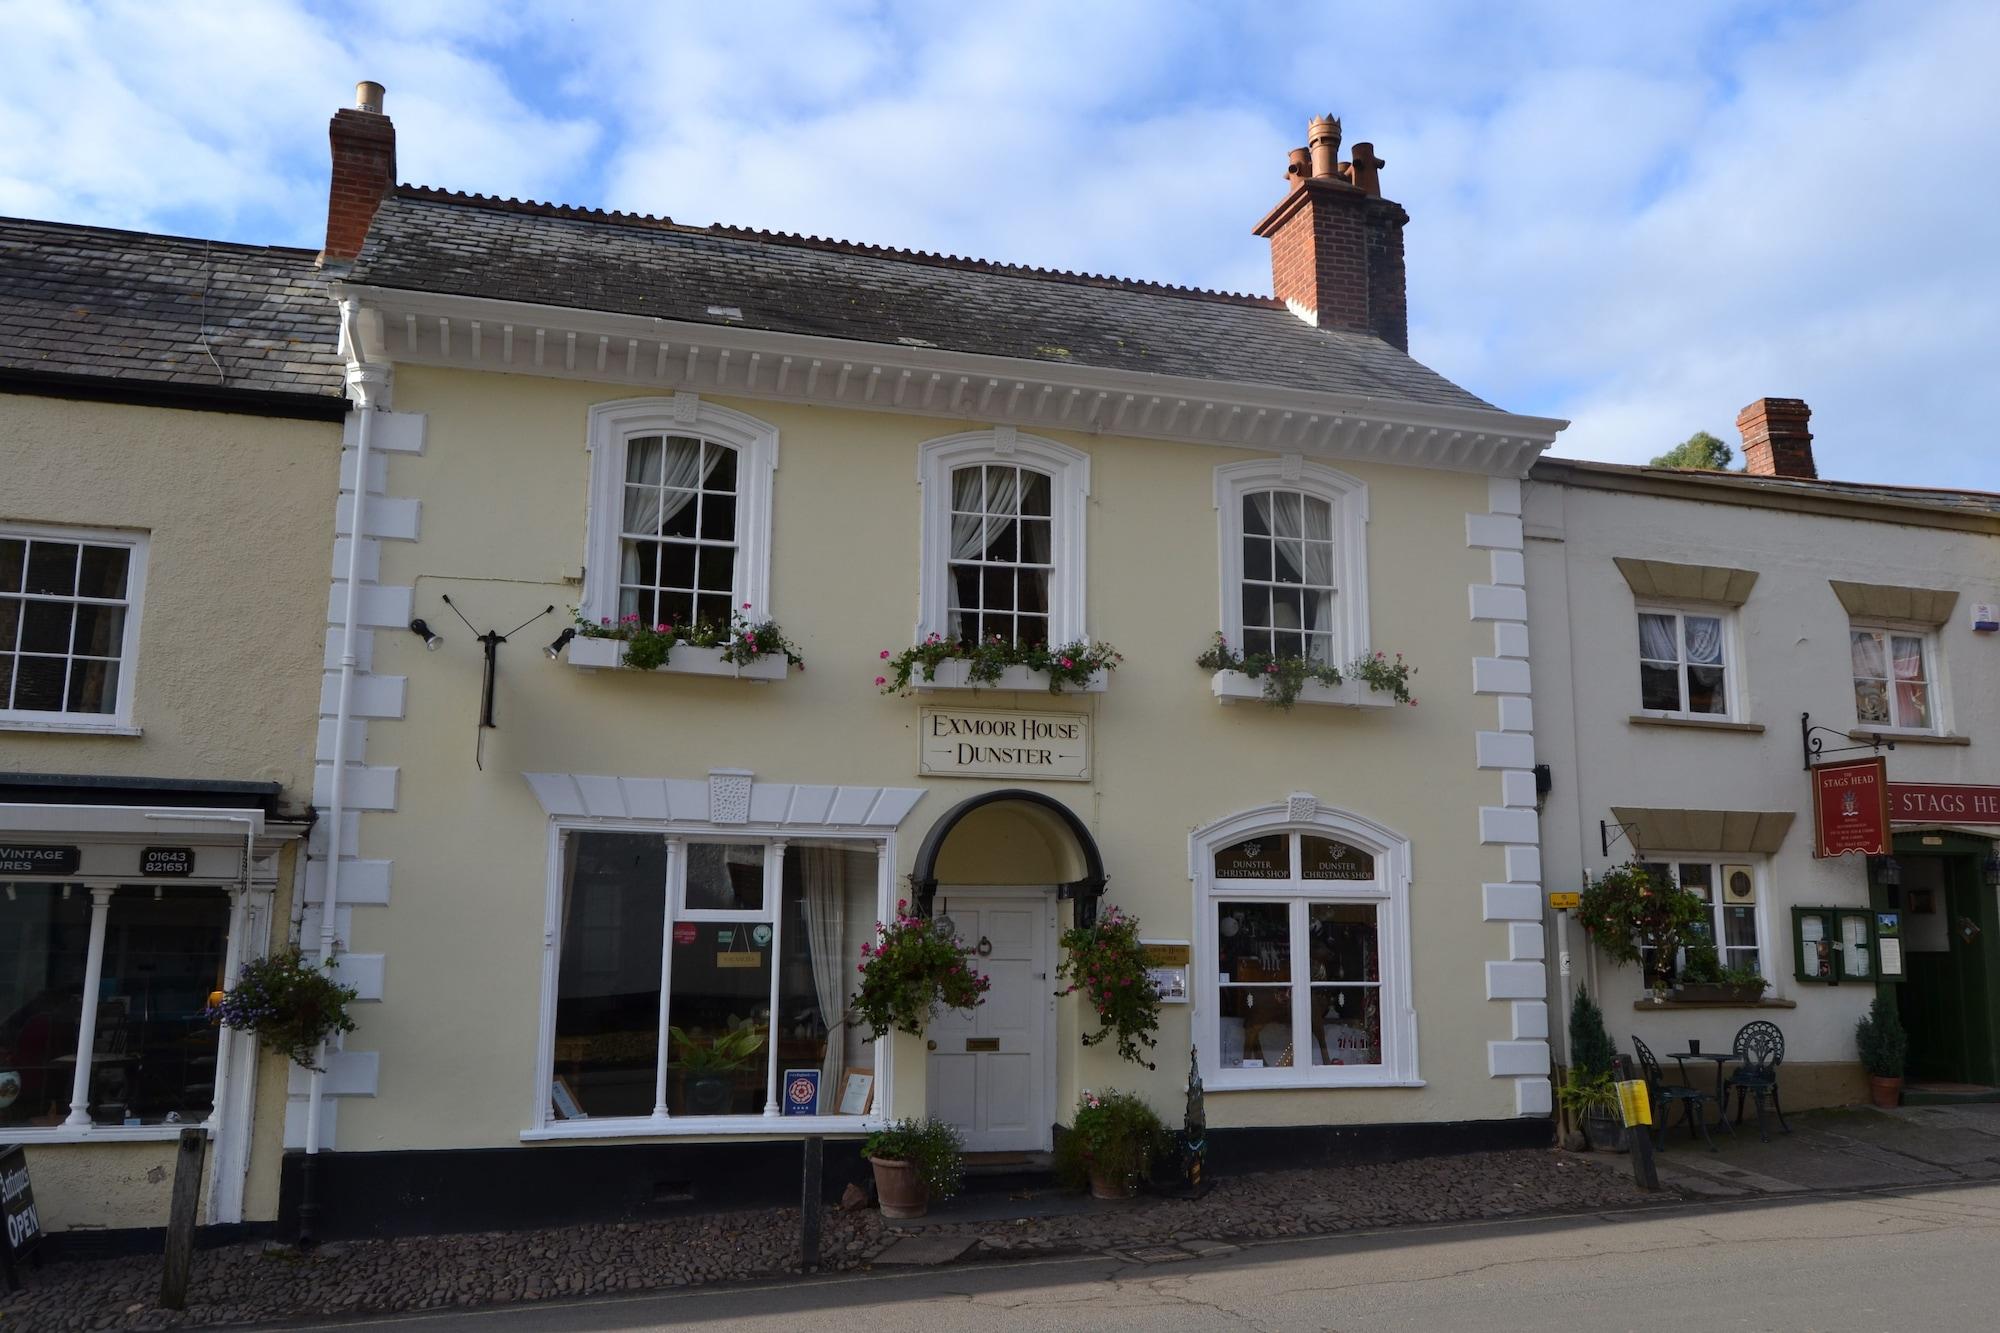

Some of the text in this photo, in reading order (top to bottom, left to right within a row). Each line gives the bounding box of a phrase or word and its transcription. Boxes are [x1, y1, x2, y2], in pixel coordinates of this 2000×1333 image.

[933, 715, 1080, 741] EXMOOR HOUSE
[958, 743, 1053, 765] DUNSTER
[1823, 775, 1874, 788] STAGS HEAD
[1903, 793, 1965, 812] STAGS
[1974, 795, 2000, 814] HE
[0, 848, 64, 860] VINTAGE
[148, 852, 186, 862] 01643
[145, 863, 188, 872] 821651
[1233, 860, 1271, 869] DUNSTER
[1319, 862, 1356, 870] DUNSTER
[1217, 868, 1289, 878] CHRISTMAS SHOP
[1303, 870, 1373, 879] CHRISTMAS SHOP
[8, 1203, 39, 1248] OPEN
